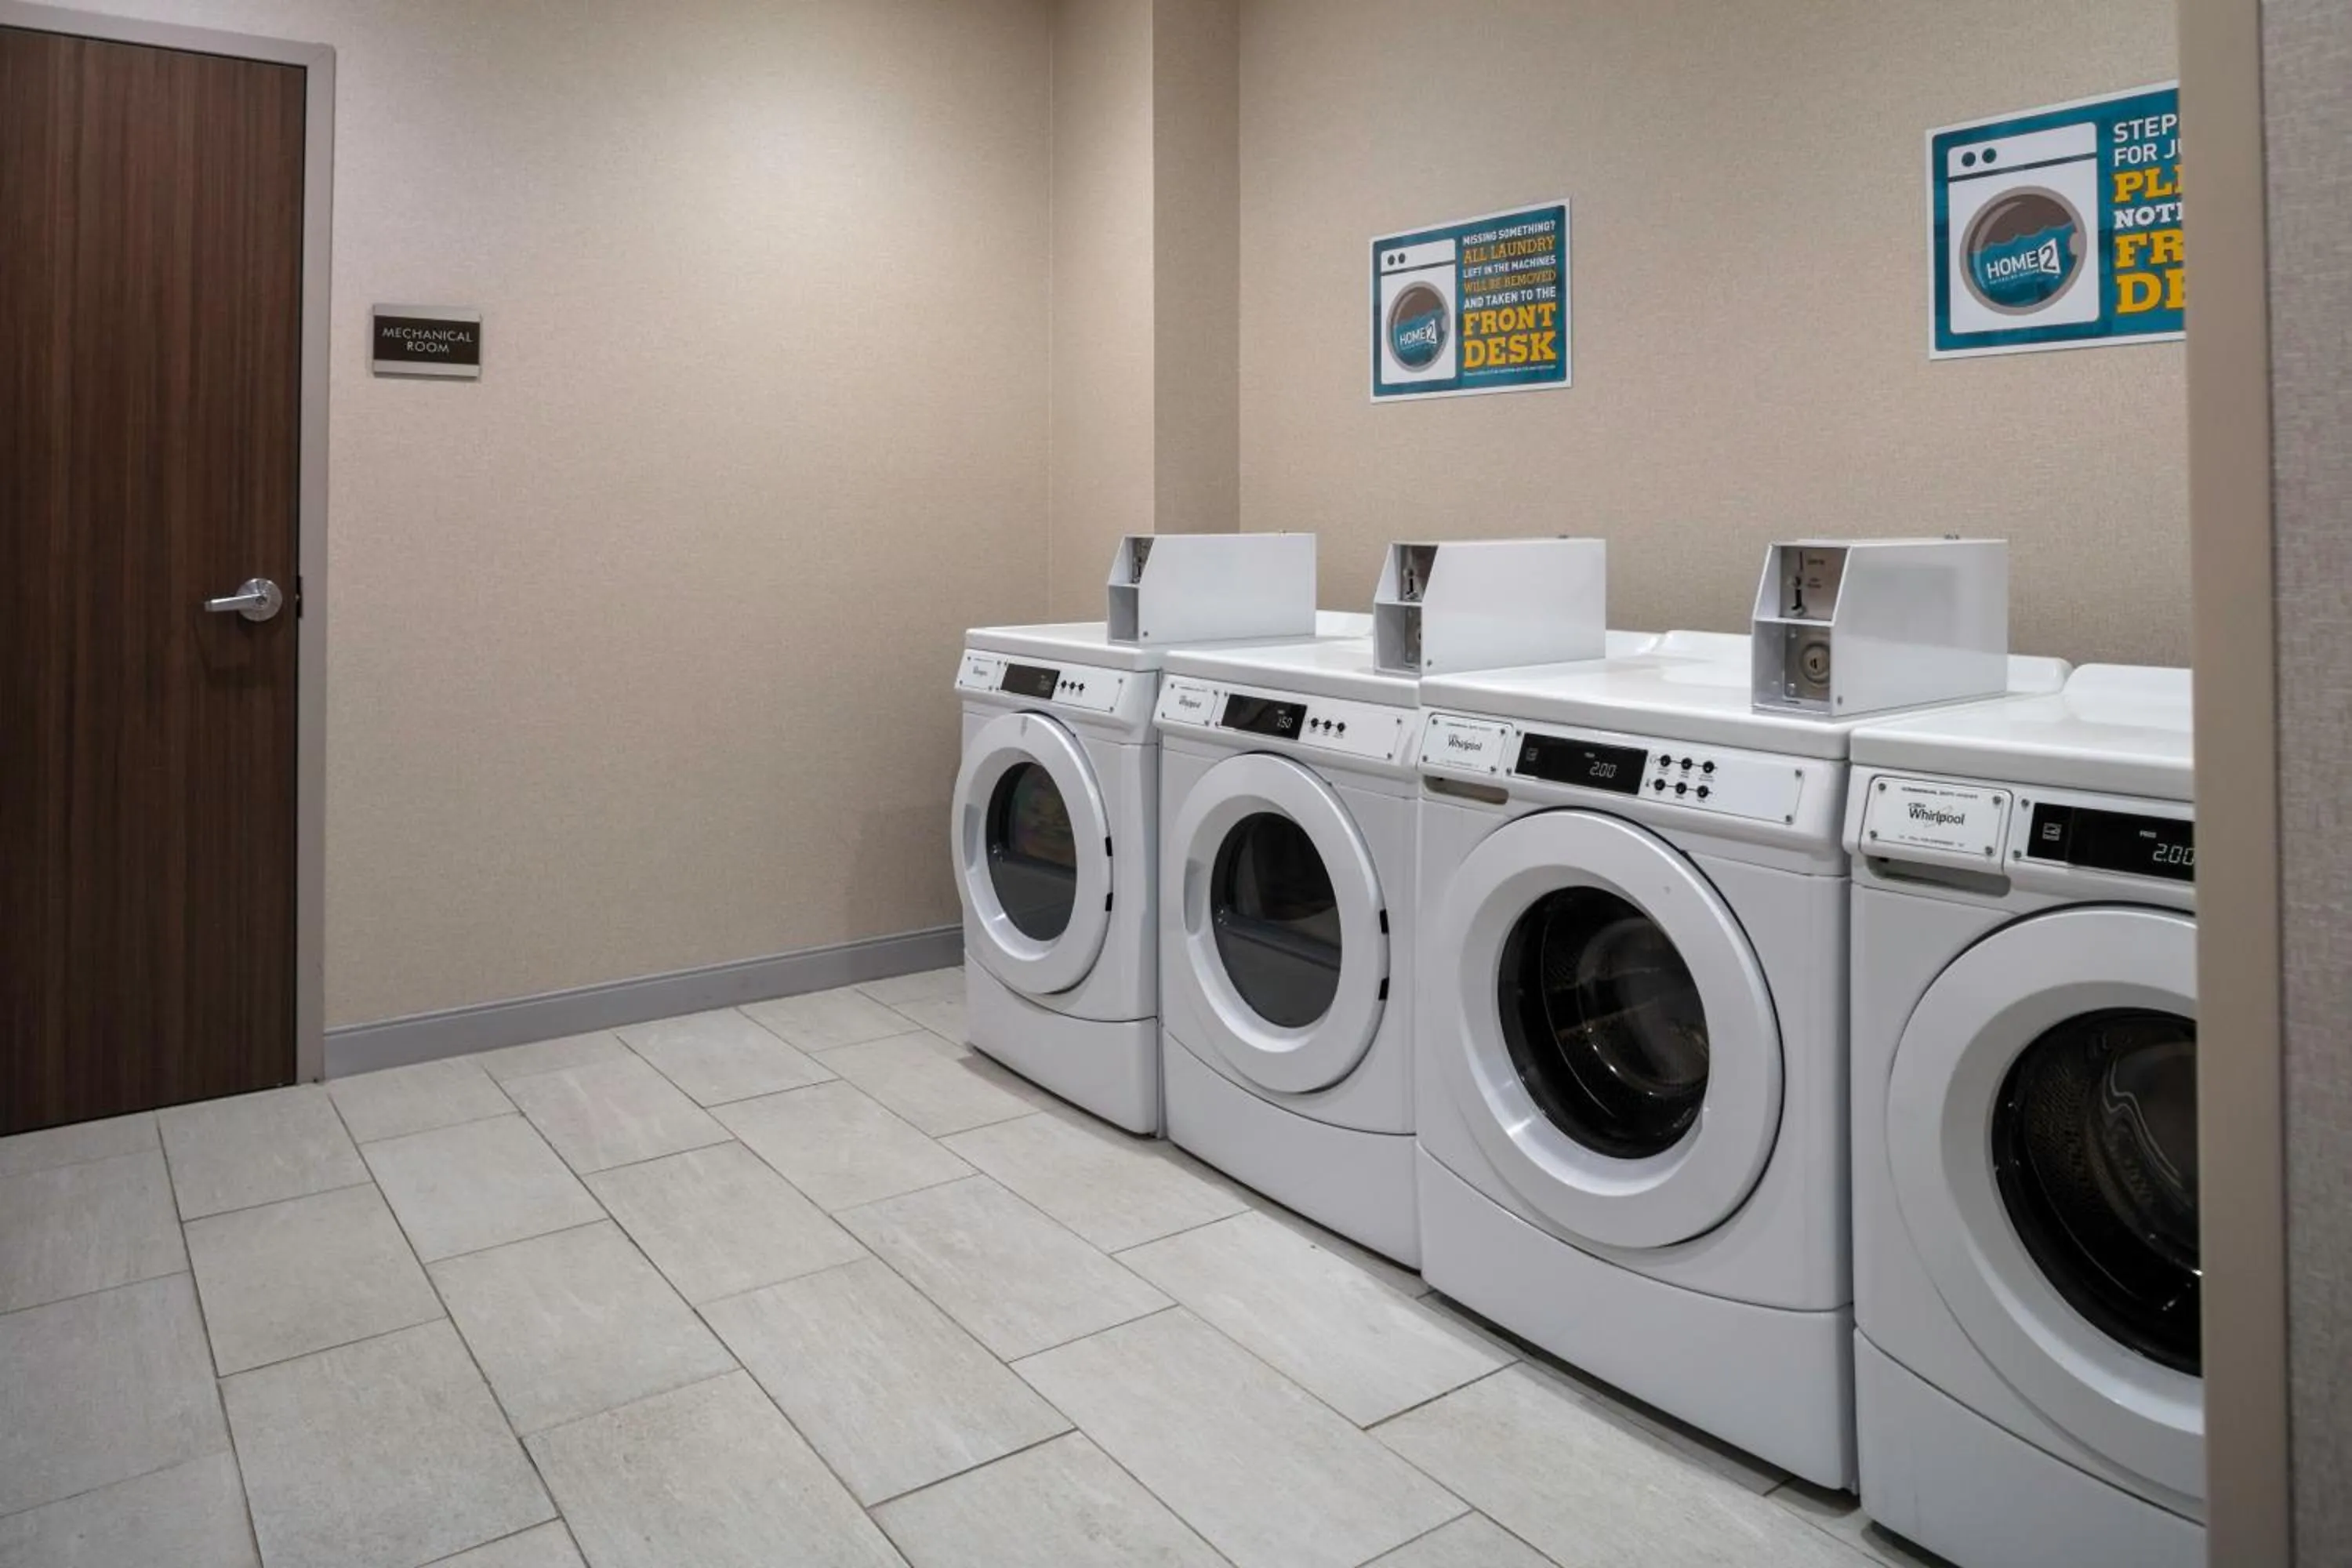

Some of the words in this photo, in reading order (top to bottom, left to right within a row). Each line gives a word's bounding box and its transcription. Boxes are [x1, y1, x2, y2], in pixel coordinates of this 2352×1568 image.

[2113, 114, 2177, 143] STEP
[2114, 143, 2158, 167] FOR
[1463, 231, 1496, 245] MISSING
[1498, 220, 1555, 240] SOMETHING?
[1464, 247, 1486, 264] ALL
[1490, 234, 1555, 260] LAUNDRY
[1494, 261, 1510, 273] THE
[1512, 255, 1555, 270] MACHINES
[1464, 297, 1483, 310] AND
[1486, 291, 1518, 306] TAKEN
[1520, 289, 1534, 302] TO
[1535, 285, 1556, 299] THE
[1464, 302, 1556, 336] FRONT
[382, 327, 474, 343] MECHANICAL
[406, 341, 449, 354] ROOM
[1464, 330, 1556, 368] DESK
[1908, 807, 1965, 826] Whirlpool
